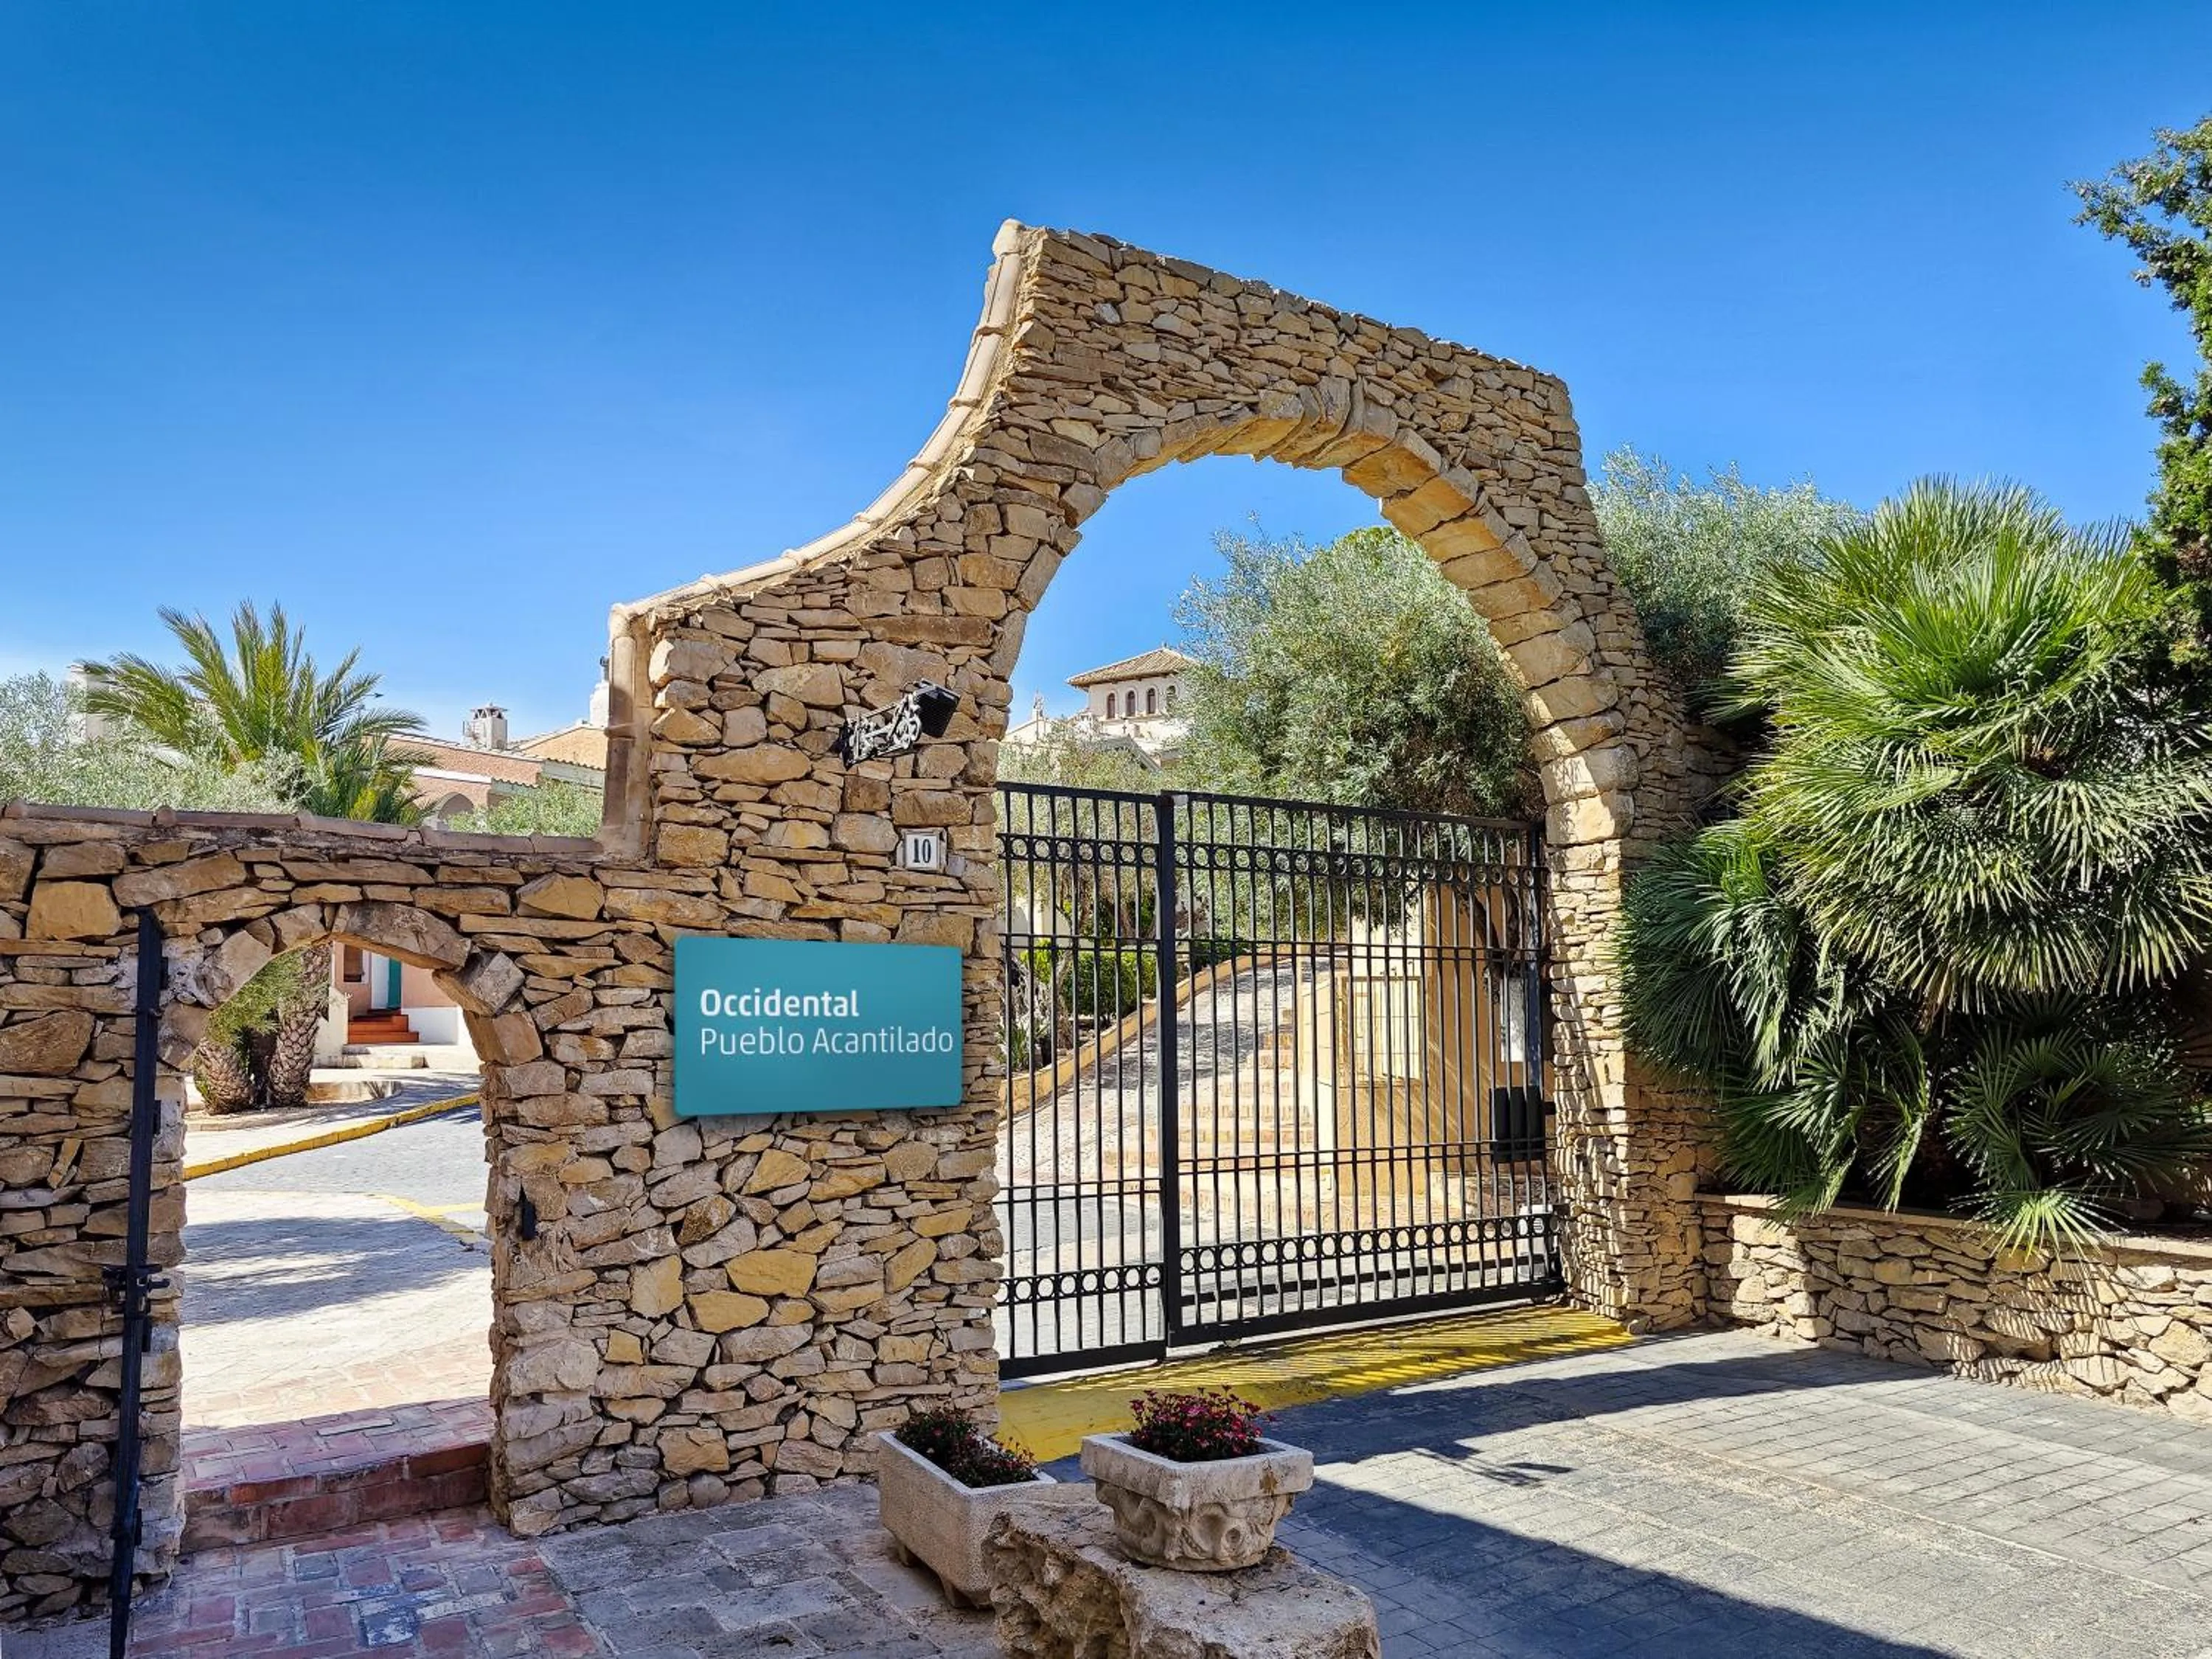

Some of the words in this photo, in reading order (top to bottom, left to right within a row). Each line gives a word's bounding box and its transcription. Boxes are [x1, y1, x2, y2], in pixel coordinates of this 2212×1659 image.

[914, 838, 931, 863] 10
[700, 988, 860, 1017] Occidental
[701, 1026, 804, 1055] Pueblo
[812, 1026, 953, 1054] Acantilado
